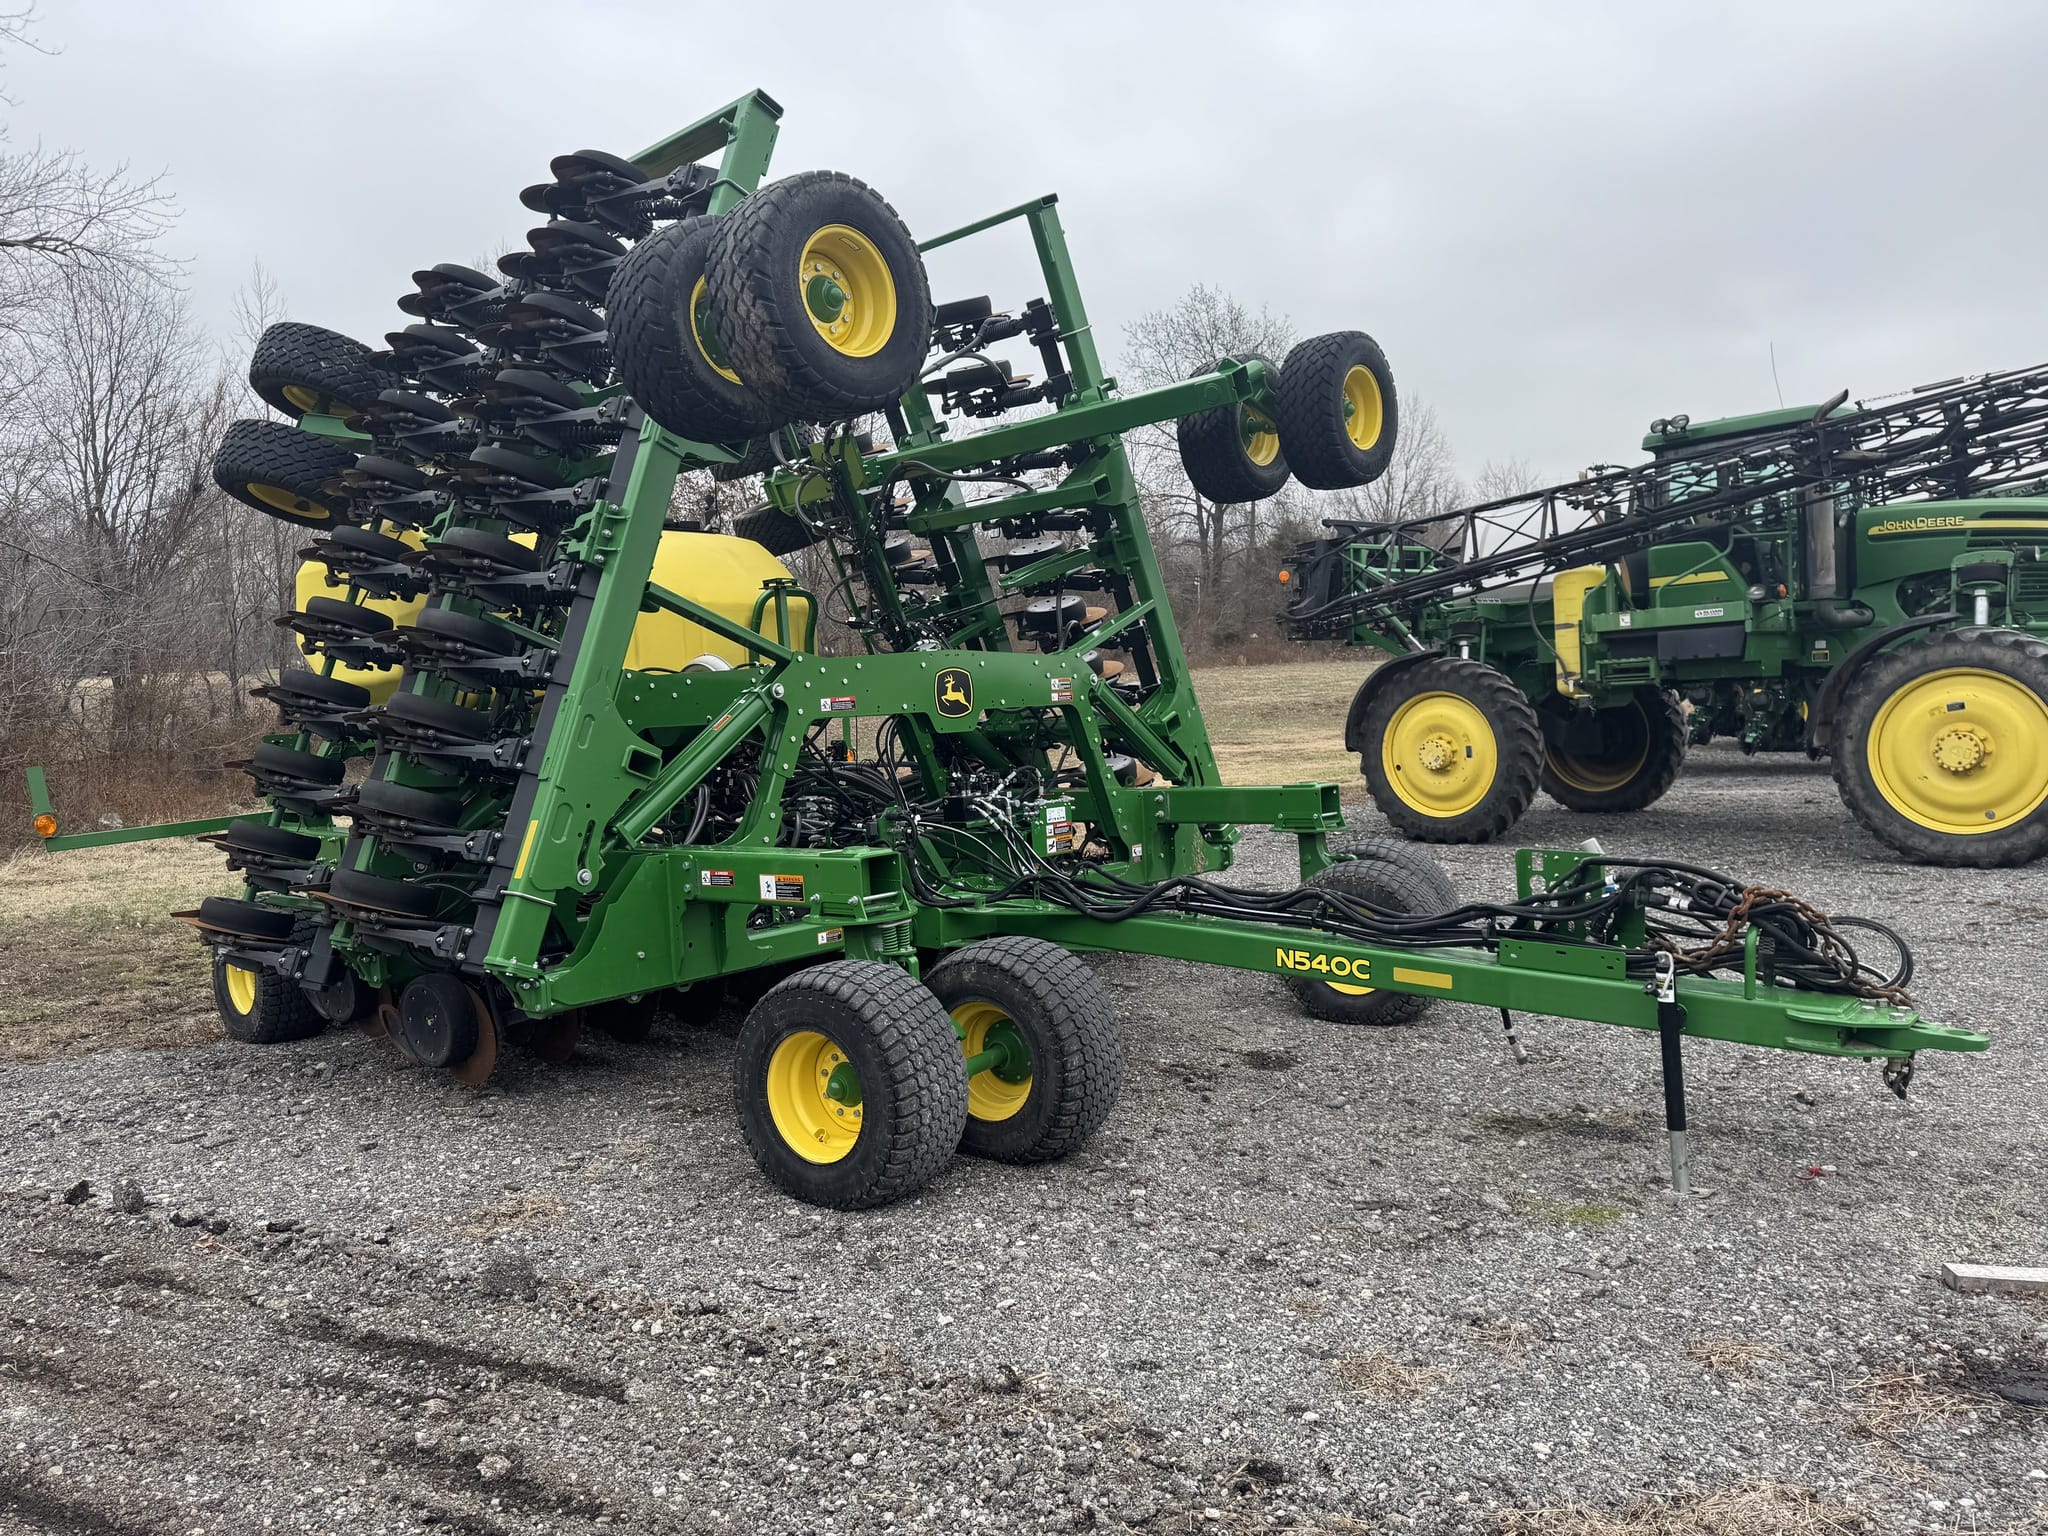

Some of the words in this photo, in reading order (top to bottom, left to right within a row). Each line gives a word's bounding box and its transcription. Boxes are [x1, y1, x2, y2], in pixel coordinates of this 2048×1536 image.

[1879, 519, 1915, 532] JOHN
[1916, 516, 1965, 528] DEERE
[1275, 947, 1370, 980] N540C
